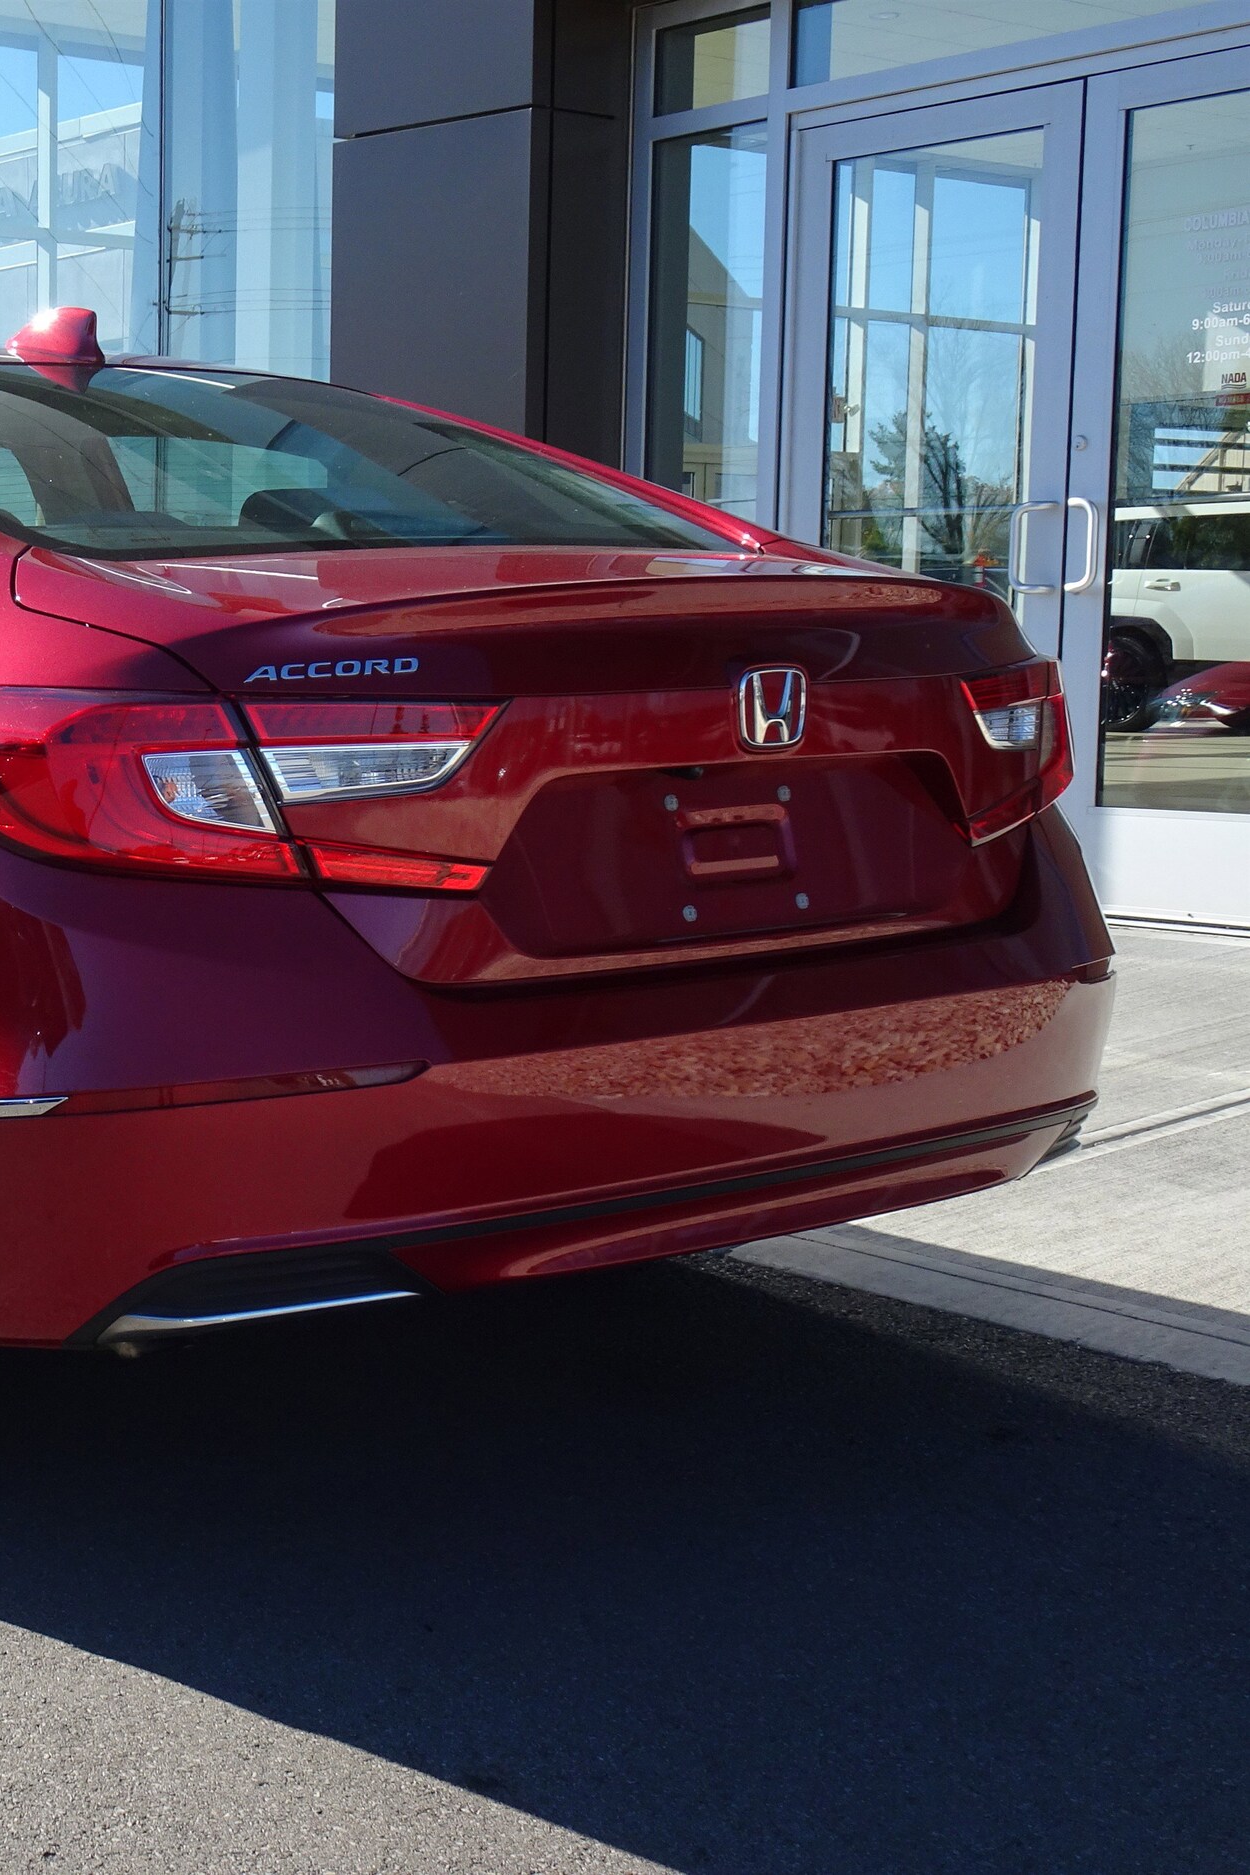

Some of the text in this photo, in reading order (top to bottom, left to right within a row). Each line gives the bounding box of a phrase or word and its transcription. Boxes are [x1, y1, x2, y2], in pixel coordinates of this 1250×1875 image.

[1183, 209, 1250, 231] COLUMBIA
[1215, 333, 1250, 347] Sund
[1221, 372, 1247, 384] NADA
[243, 657, 419, 683] ACCORD
